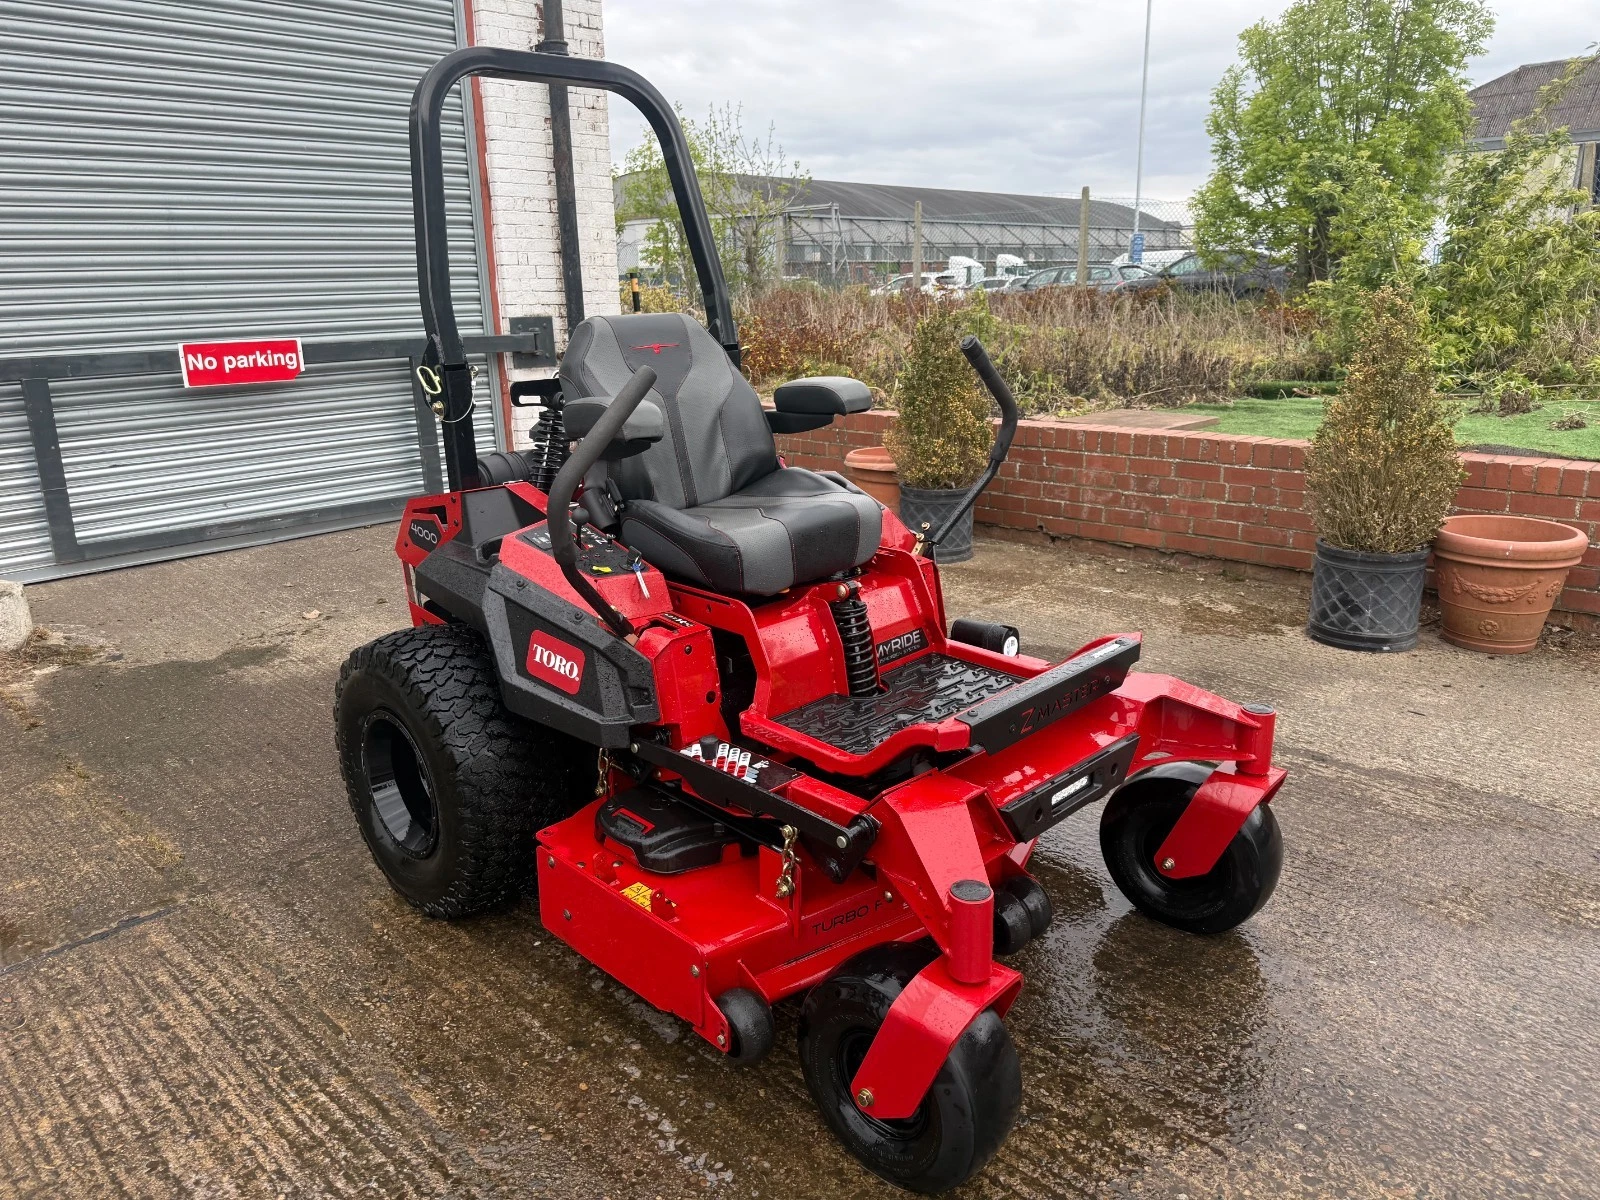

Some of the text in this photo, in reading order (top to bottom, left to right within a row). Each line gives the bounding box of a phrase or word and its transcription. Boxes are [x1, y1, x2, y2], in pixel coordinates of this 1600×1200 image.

[187, 350, 298, 373] No parking
[411, 523, 438, 544] 4000
[812, 905, 869, 936] TURBO
